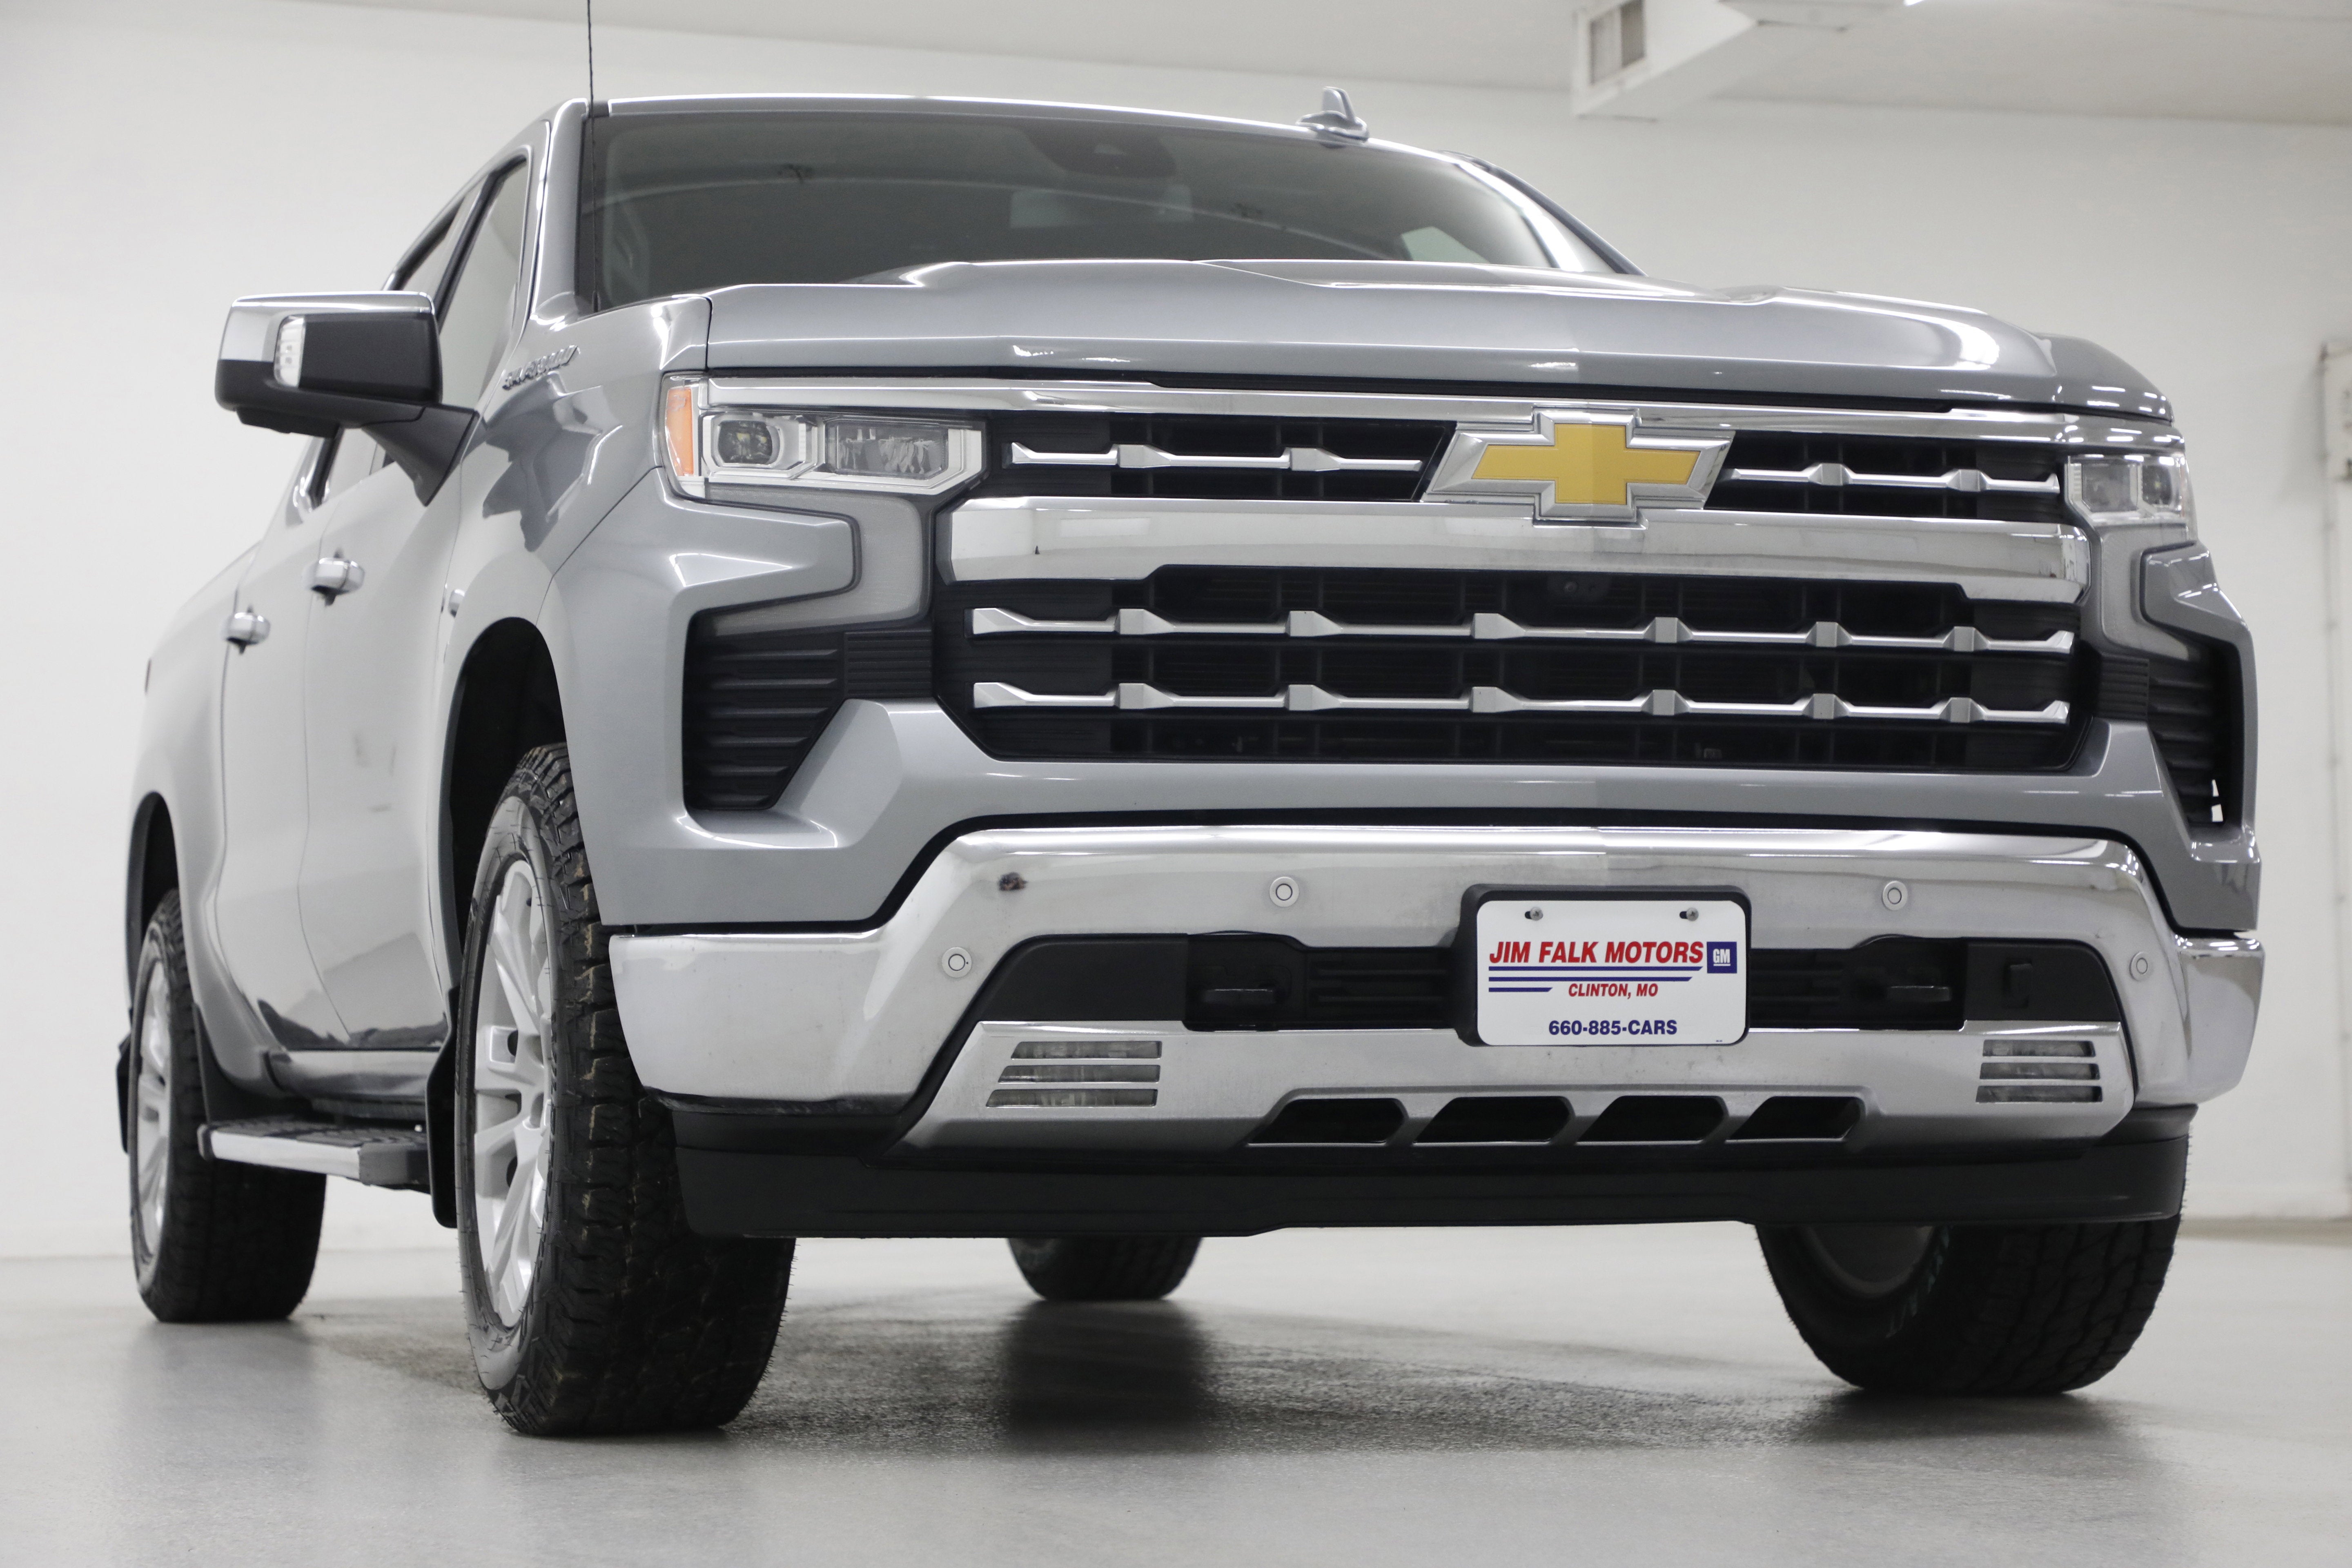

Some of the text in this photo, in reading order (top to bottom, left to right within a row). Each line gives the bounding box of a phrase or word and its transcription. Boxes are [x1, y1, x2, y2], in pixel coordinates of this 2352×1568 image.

[1489, 941, 1704, 964] JIM FALK MOTORS
[1713, 949, 1731, 964] GM
[1568, 983, 1659, 1000] CLINTON, MO
[1548, 1020, 1678, 1036] 660-885-CARS
